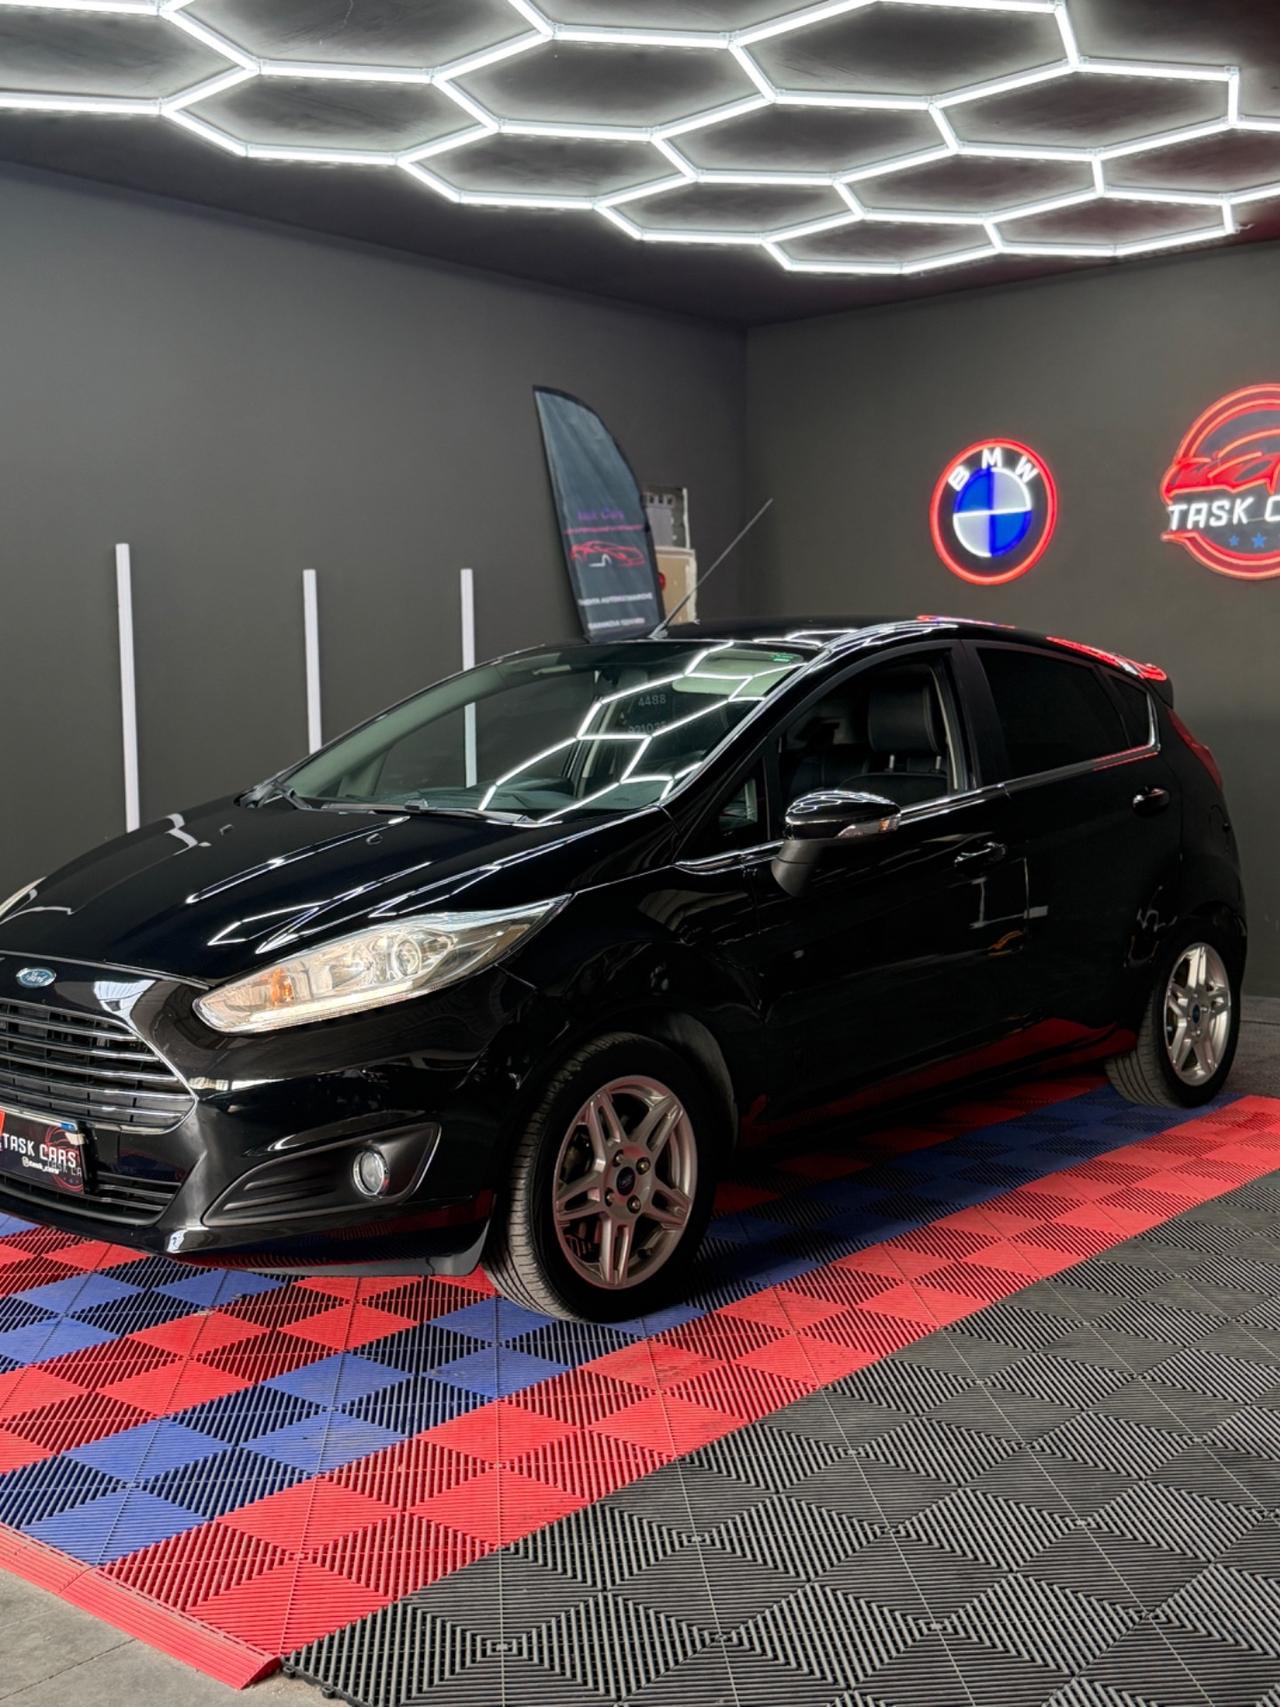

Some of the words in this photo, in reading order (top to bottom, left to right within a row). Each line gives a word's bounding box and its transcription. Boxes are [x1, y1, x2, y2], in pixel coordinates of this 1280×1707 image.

[947, 446, 1039, 491] BMW
[1166, 496, 1255, 531] TASK
[2, 1132, 35, 1157] TASK
[39, 1143, 77, 1168] CARS
